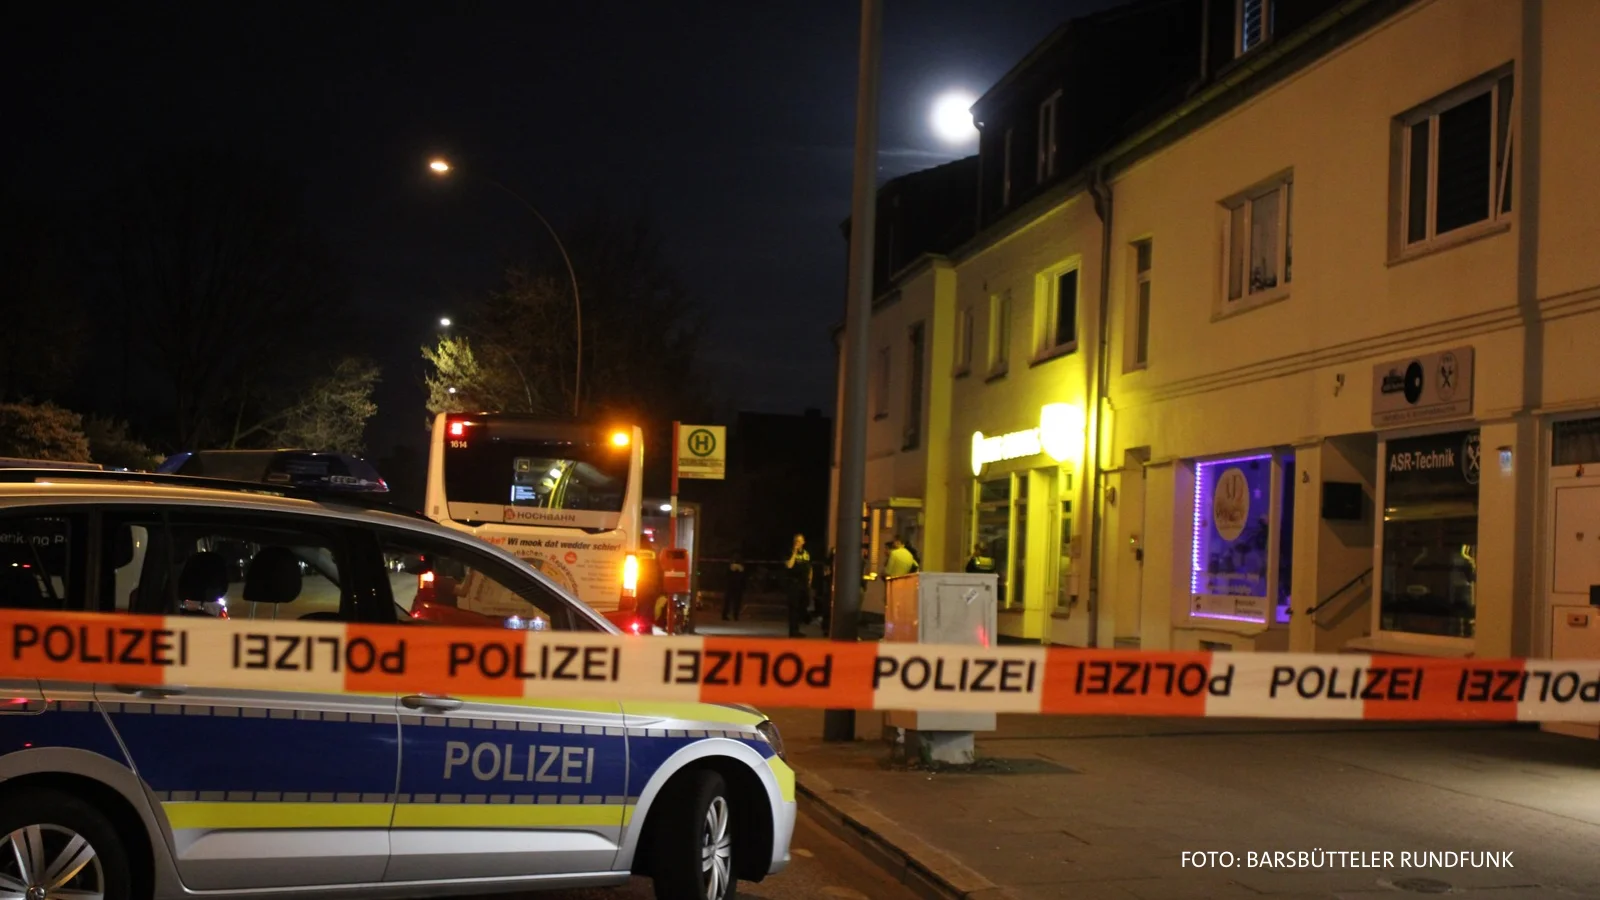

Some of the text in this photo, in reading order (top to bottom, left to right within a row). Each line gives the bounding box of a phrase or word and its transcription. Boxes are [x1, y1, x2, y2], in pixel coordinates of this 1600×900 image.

[695, 435, 709, 451] H
[1390, 448, 1455, 471] ASR-Technik
[517, 511, 576, 522] HOCHBAHN
[508, 537, 519, 546] Wi
[520, 538, 542, 547] mook
[544, 540, 558, 548] dat
[560, 540, 590, 550] wedder
[12, 623, 189, 666] POLIZEI
[233, 632, 407, 675] POLIZEI
[448, 642, 620, 682] POLIZEI
[663, 649, 833, 688] POLIZEI
[872, 655, 1037, 693] POLIZEI
[1075, 660, 1235, 697] POLIZEI
[1269, 666, 1424, 701] POLIZEI
[1457, 668, 1600, 703] POLIZEI
[443, 740, 595, 784] POLIZEI
